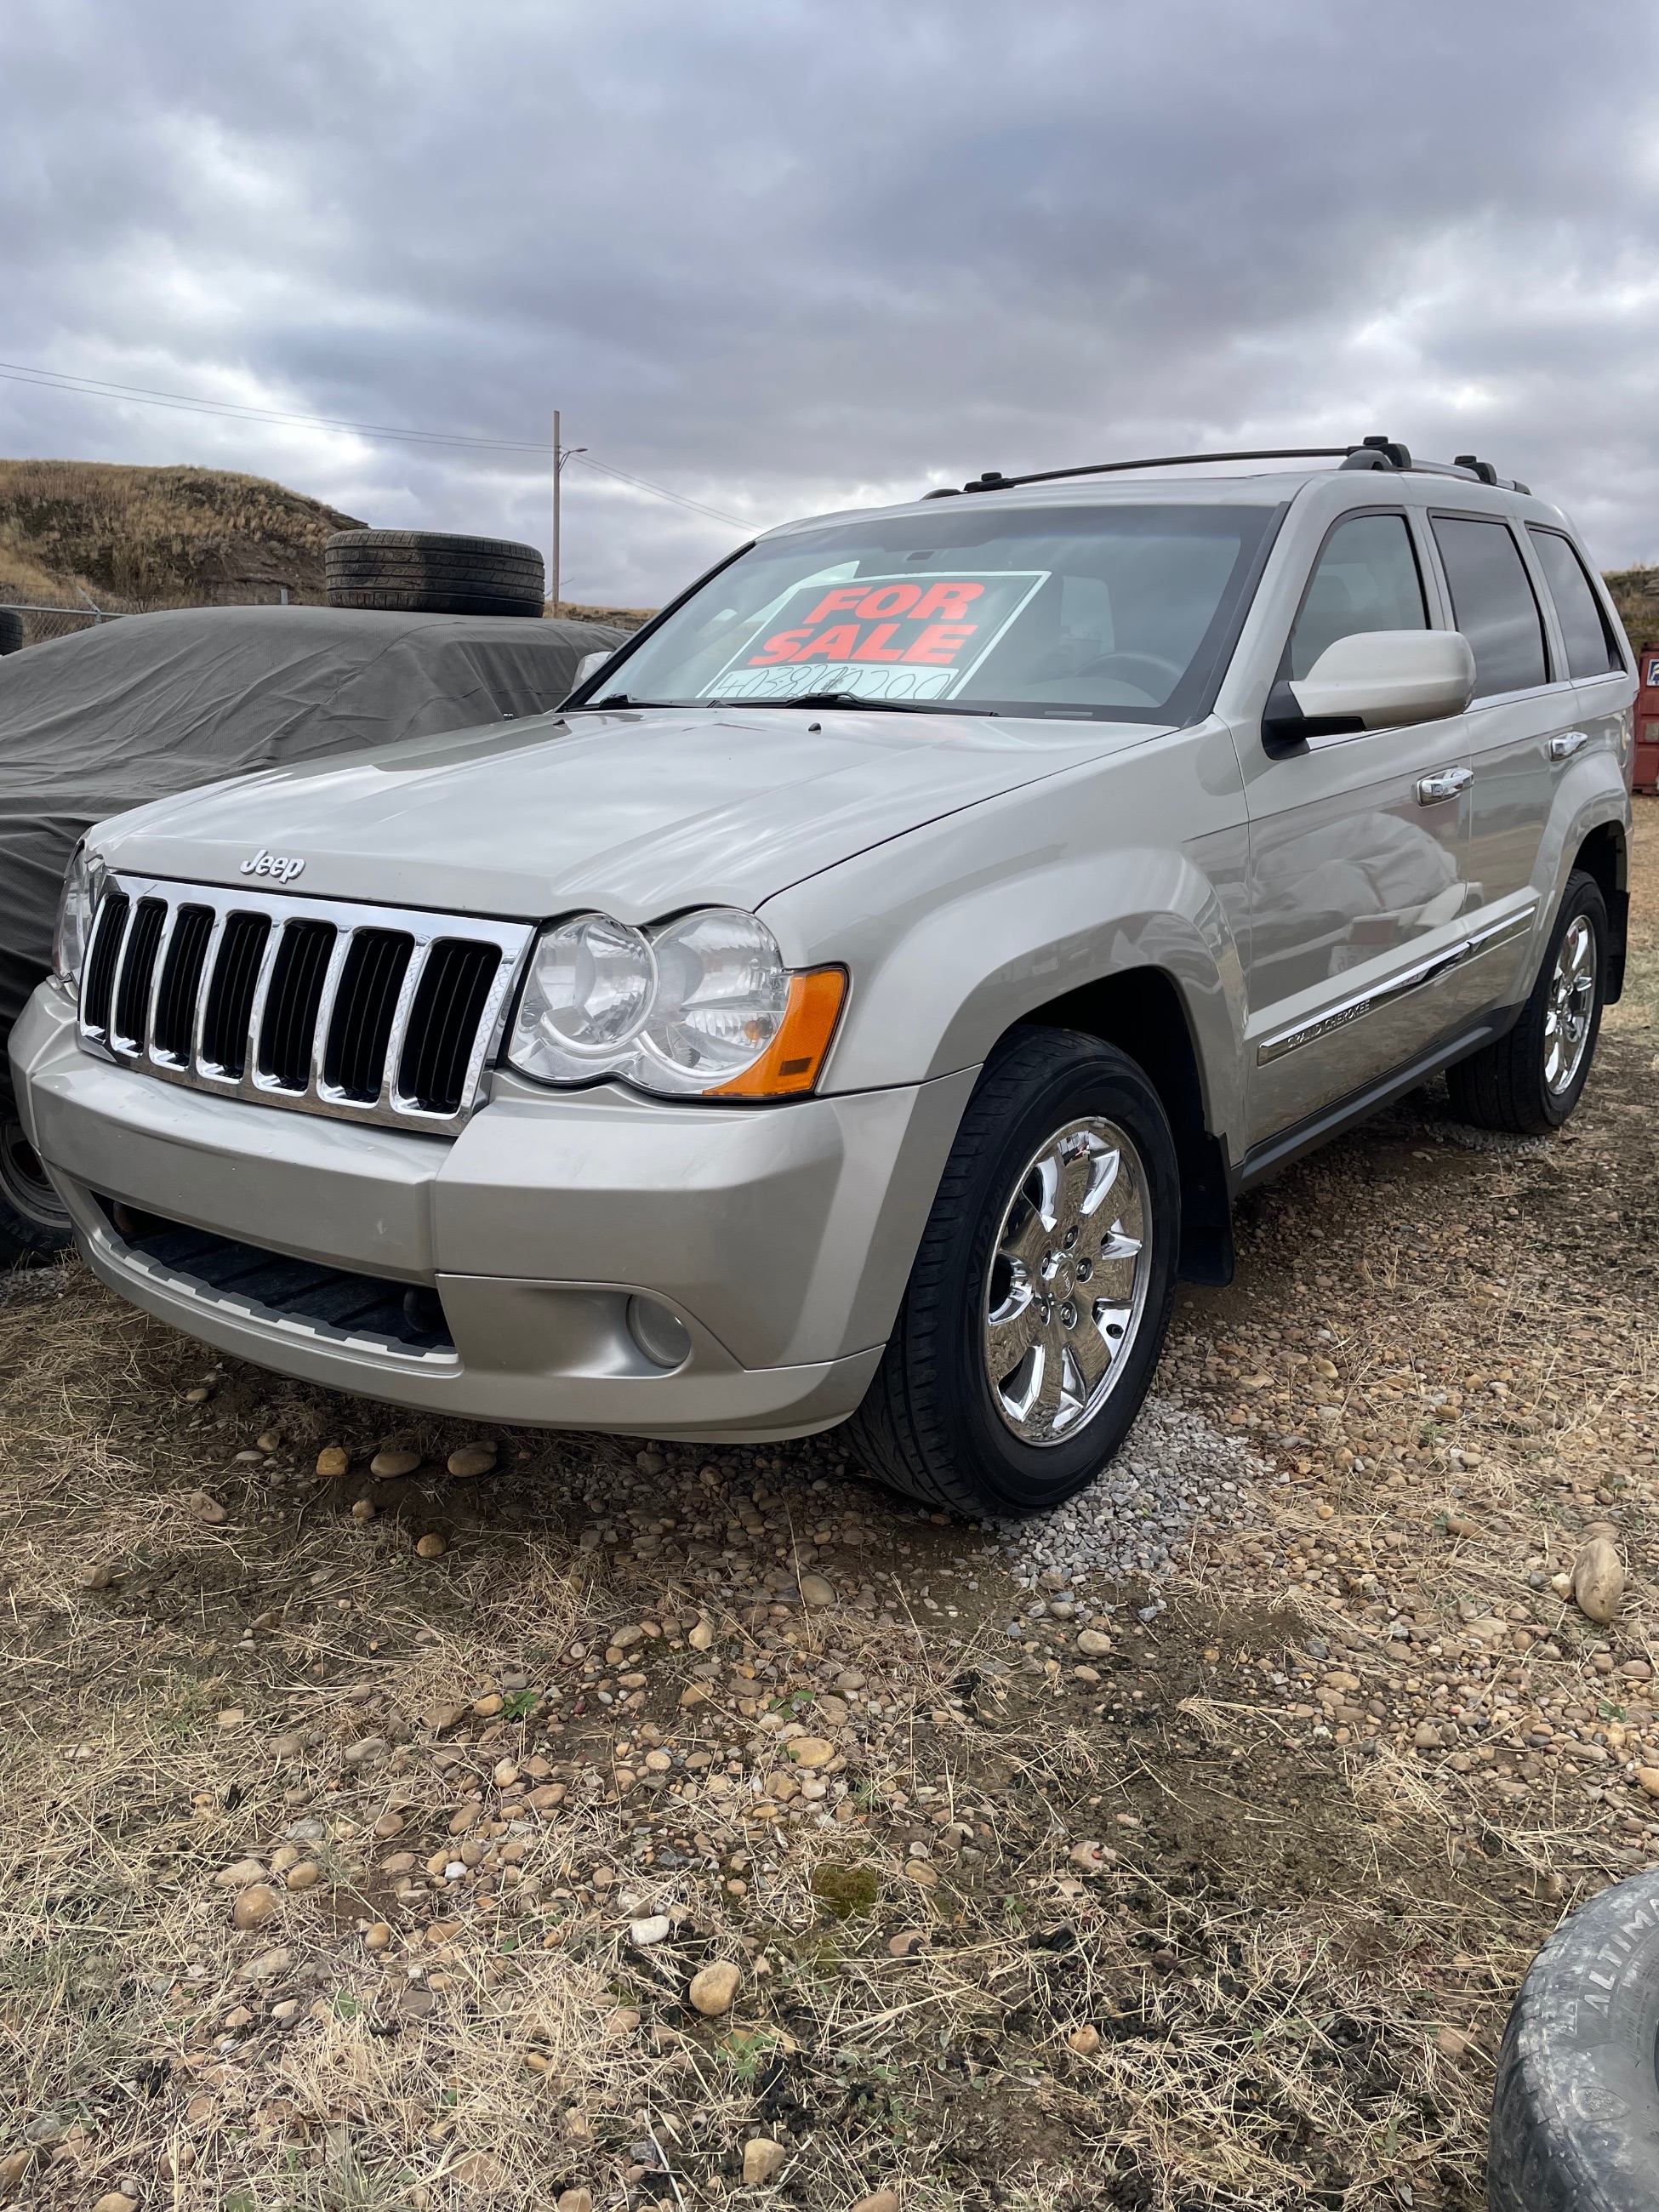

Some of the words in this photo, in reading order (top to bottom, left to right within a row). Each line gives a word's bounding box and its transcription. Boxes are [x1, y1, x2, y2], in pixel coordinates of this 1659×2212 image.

[802, 582, 985, 624] FOR
[746, 623, 979, 666] SALE
[240, 849, 306, 884] Jeep
[1287, 1023, 1322, 1048] GRAND
[1325, 999, 1371, 1031] CHEROKEE
